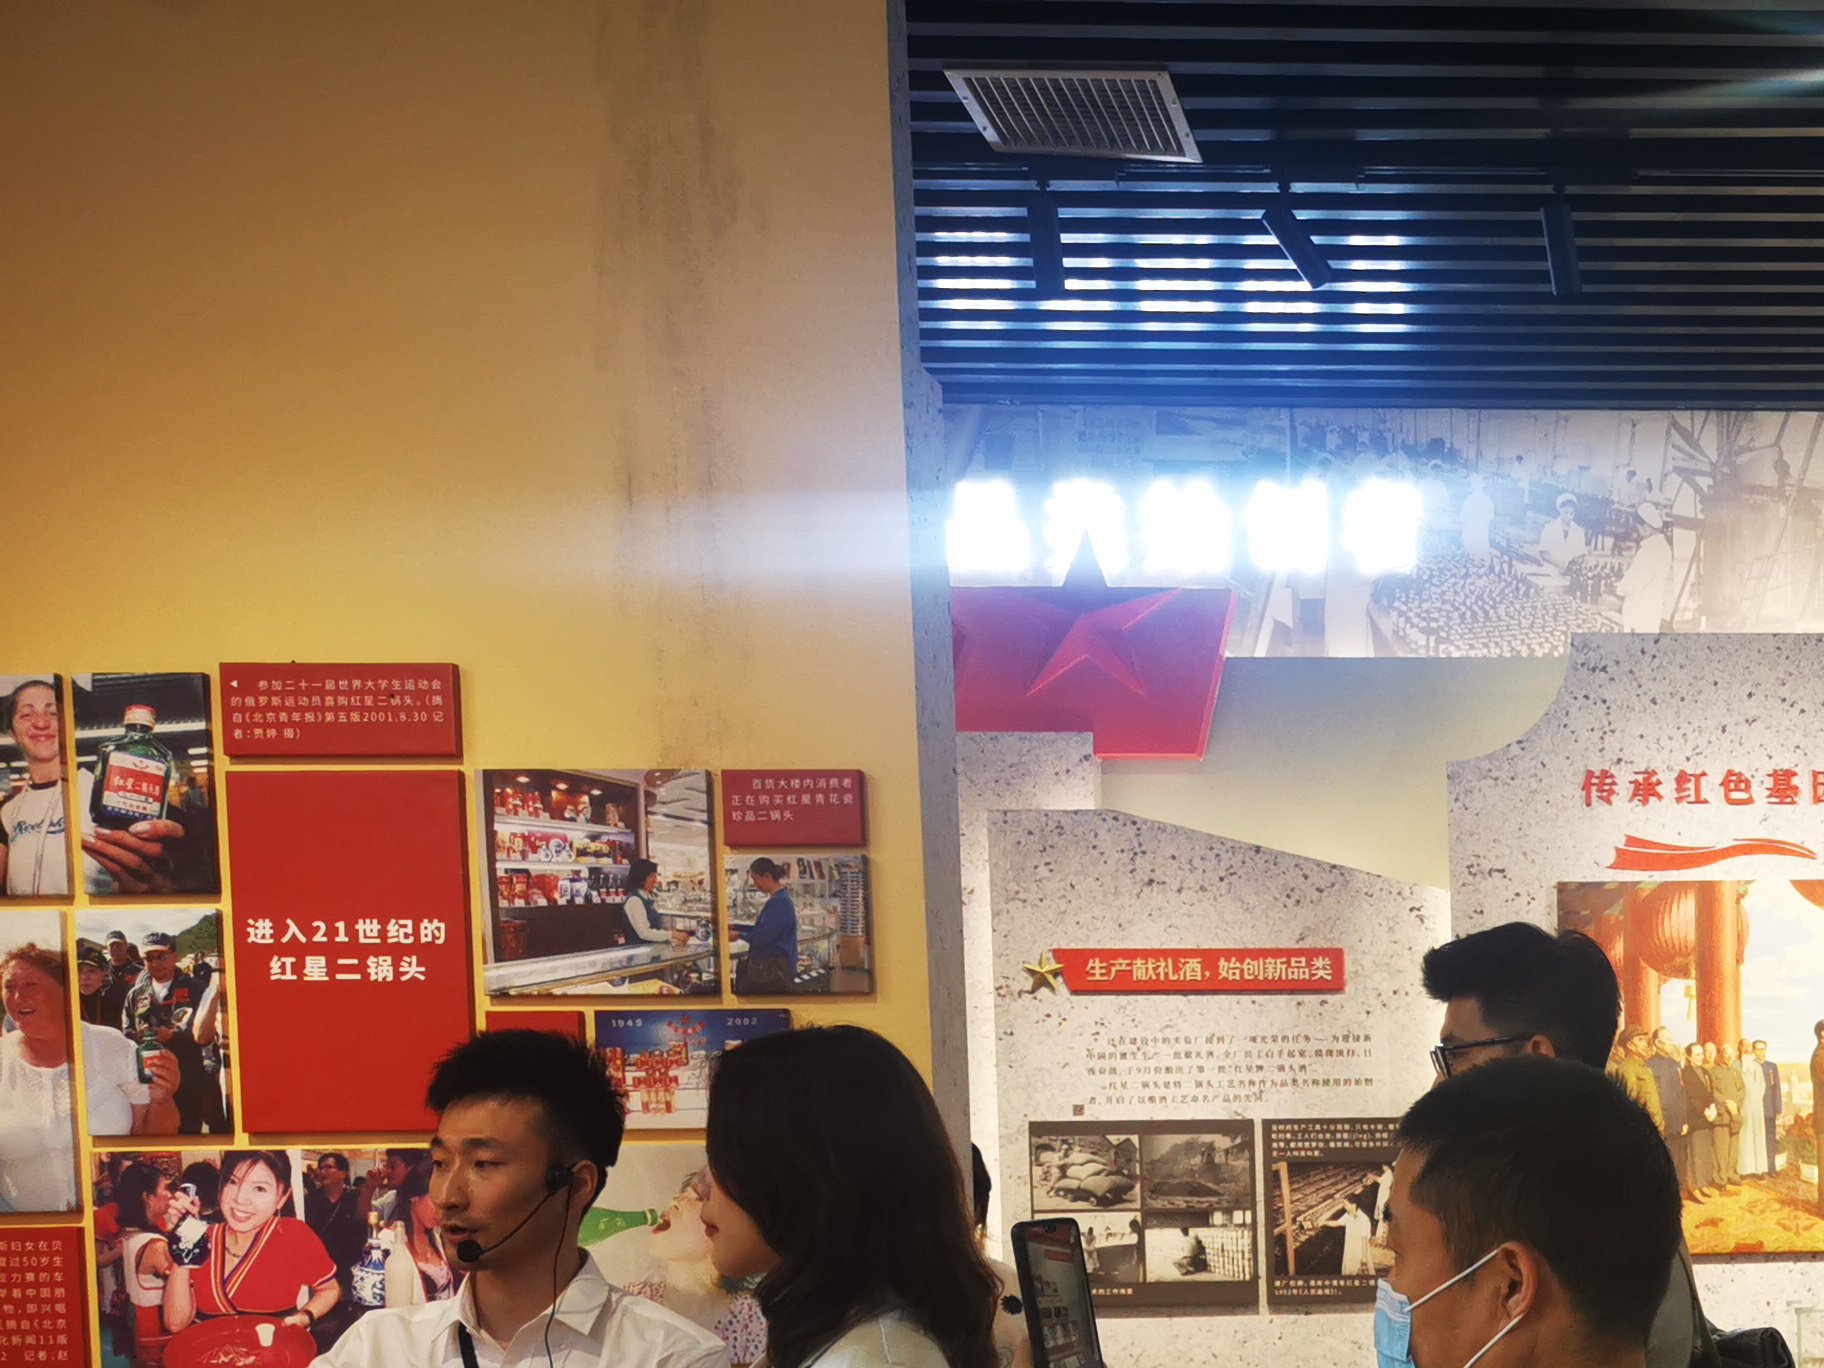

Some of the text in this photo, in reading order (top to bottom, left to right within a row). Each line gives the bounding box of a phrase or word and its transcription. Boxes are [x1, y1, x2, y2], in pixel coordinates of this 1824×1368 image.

[246, 918, 446, 945] 进入21世纪的
[269, 955, 427, 982] 红星二锅头
[1085, 956, 1333, 982] 生产献礼酒，始创新品类
[726, 1017, 758, 1026] 2002
